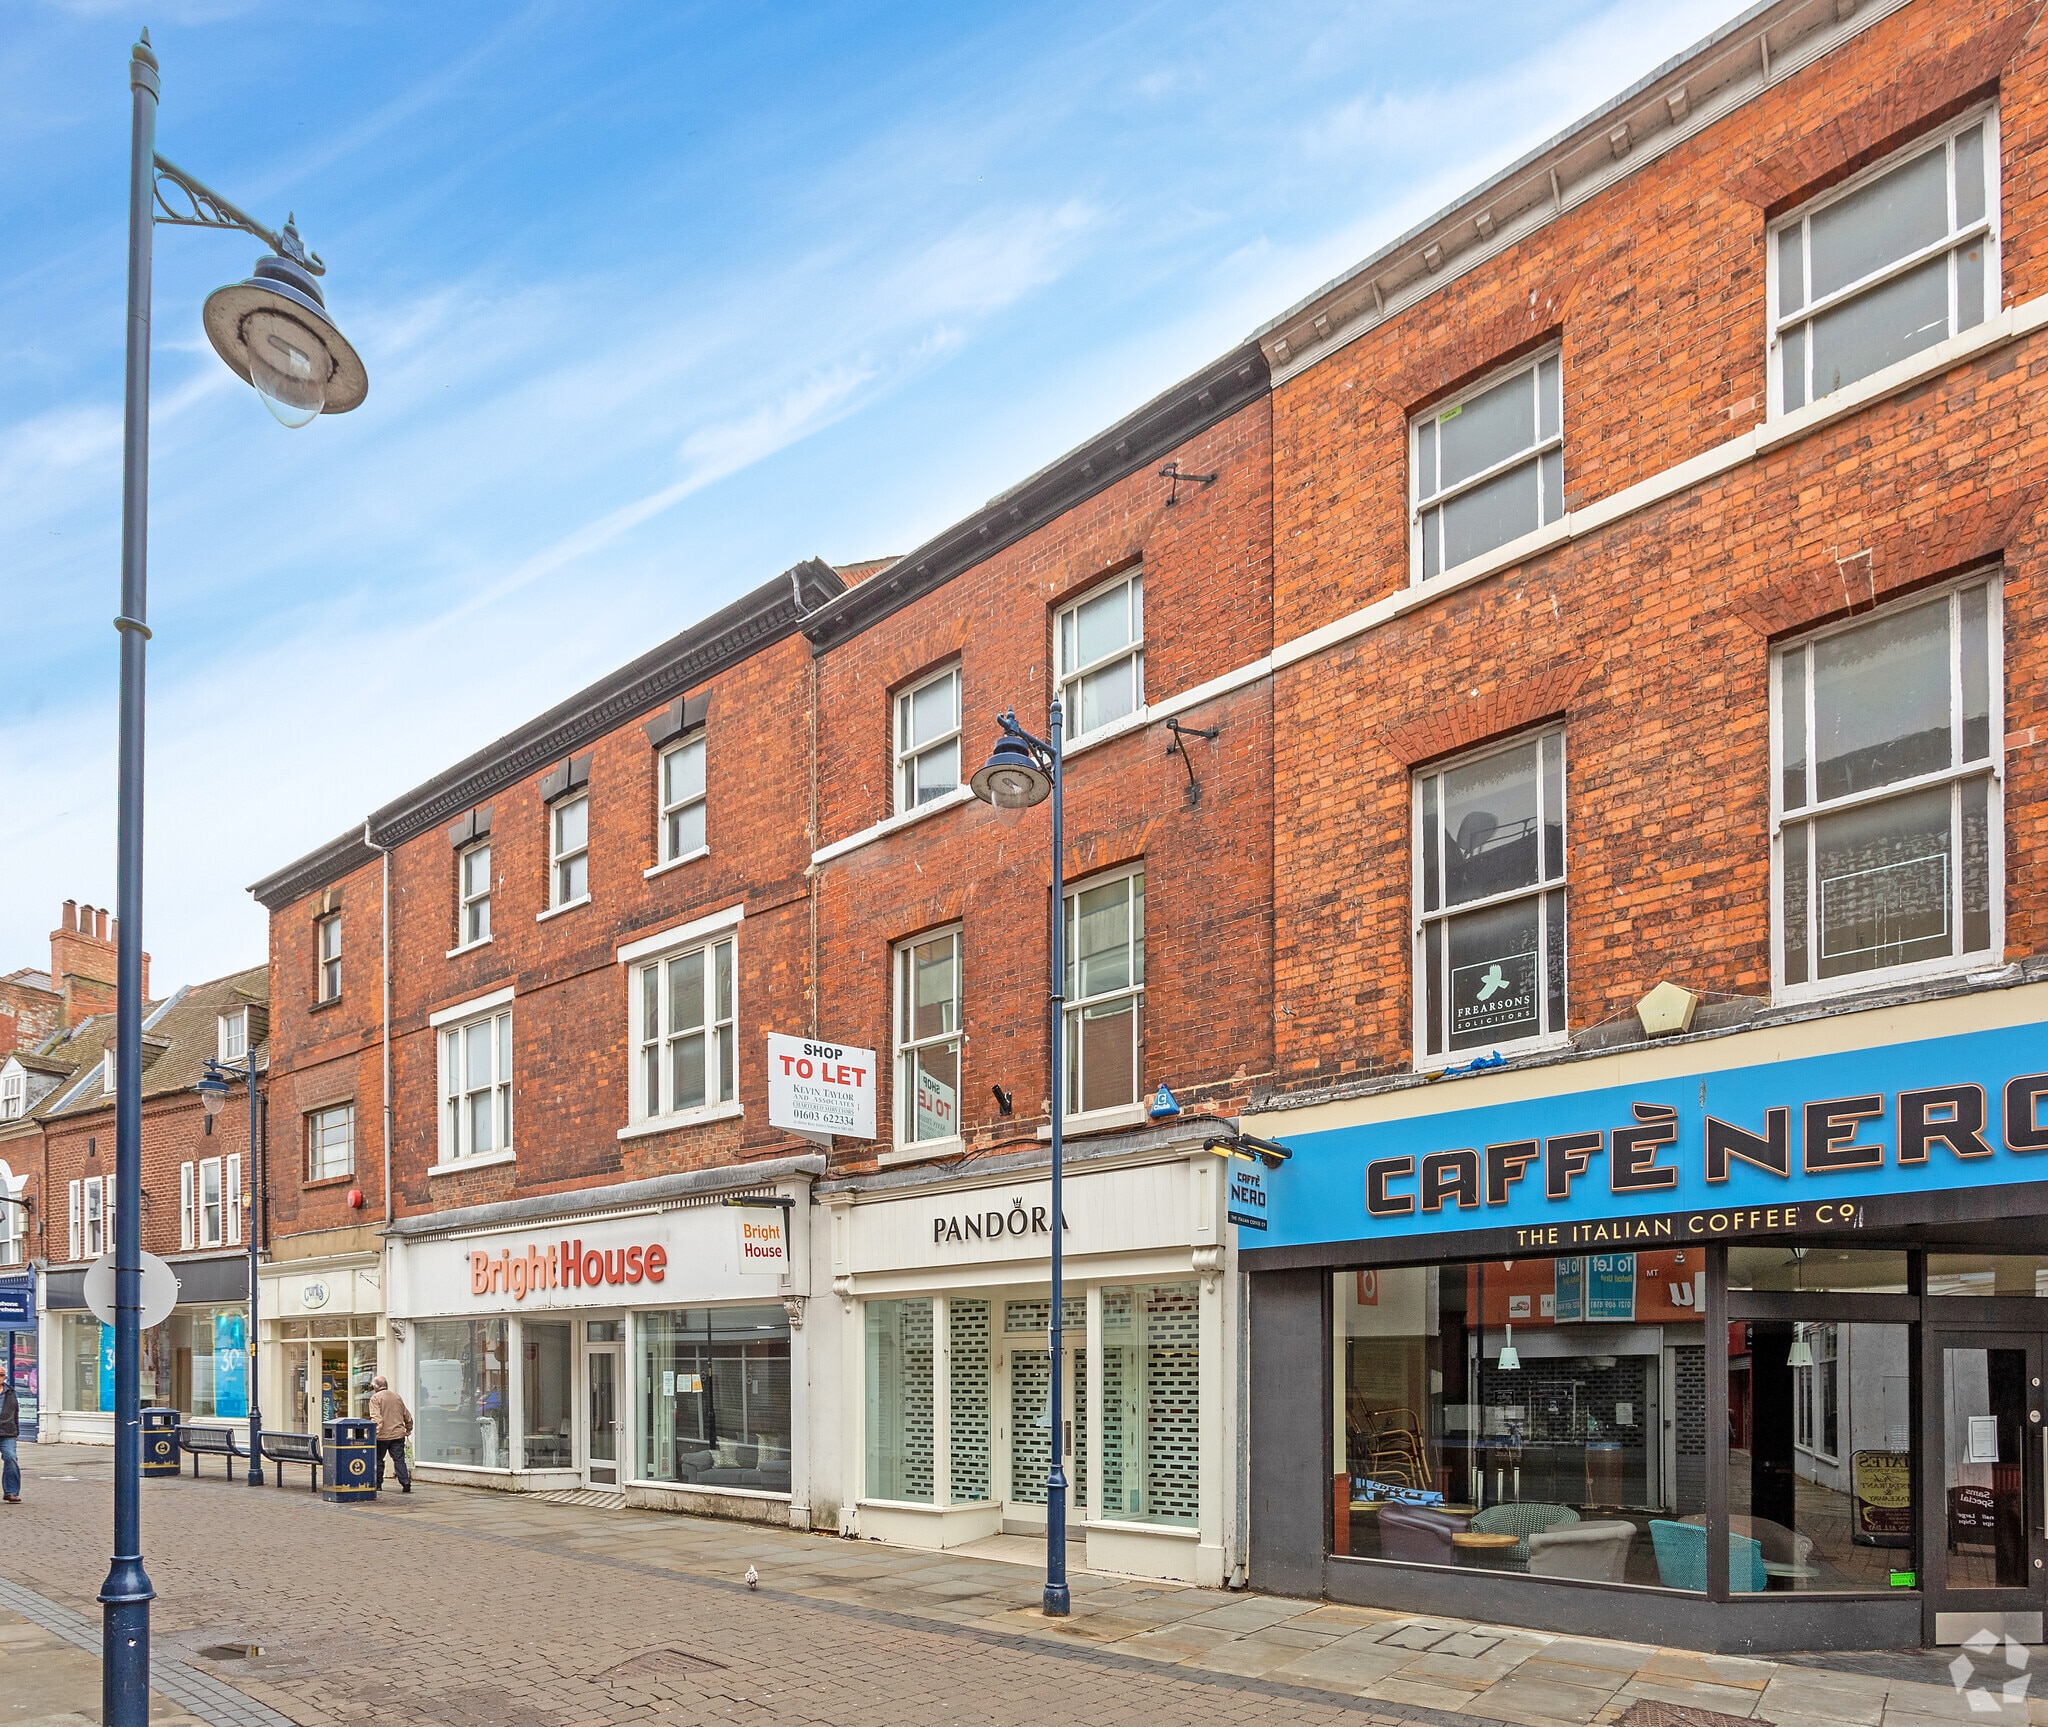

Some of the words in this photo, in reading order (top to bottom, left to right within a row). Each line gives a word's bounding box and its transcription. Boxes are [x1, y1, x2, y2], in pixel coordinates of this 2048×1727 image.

[1458, 995, 1530, 1018] FREARSONS
[1458, 1010, 1530, 1029] SOLICITORS
[803, 1043, 843, 1060] SHOP
[779, 1055, 813, 1079] TO
[822, 1062, 866, 1087] LET
[793, 1084, 820, 1096] KEVIN
[822, 1088, 854, 1101] TAYLOR
[793, 1093, 809, 1101] AND
[814, 1097, 854, 1107] ASSOCIATES
[793, 1109, 819, 1121] 01603
[823, 1114, 854, 1126] 622334
[1366, 1101, 1678, 1217] CAFFÈ
[1231, 1182, 1266, 1208] NERO
[742, 1223, 781, 1241] Bright
[1517, 1225, 1558, 1248] THE
[1572, 1218, 1672, 1243] ITALIAN
[1688, 1207, 1797, 1234] COFFEE
[745, 1242, 782, 1259] House
